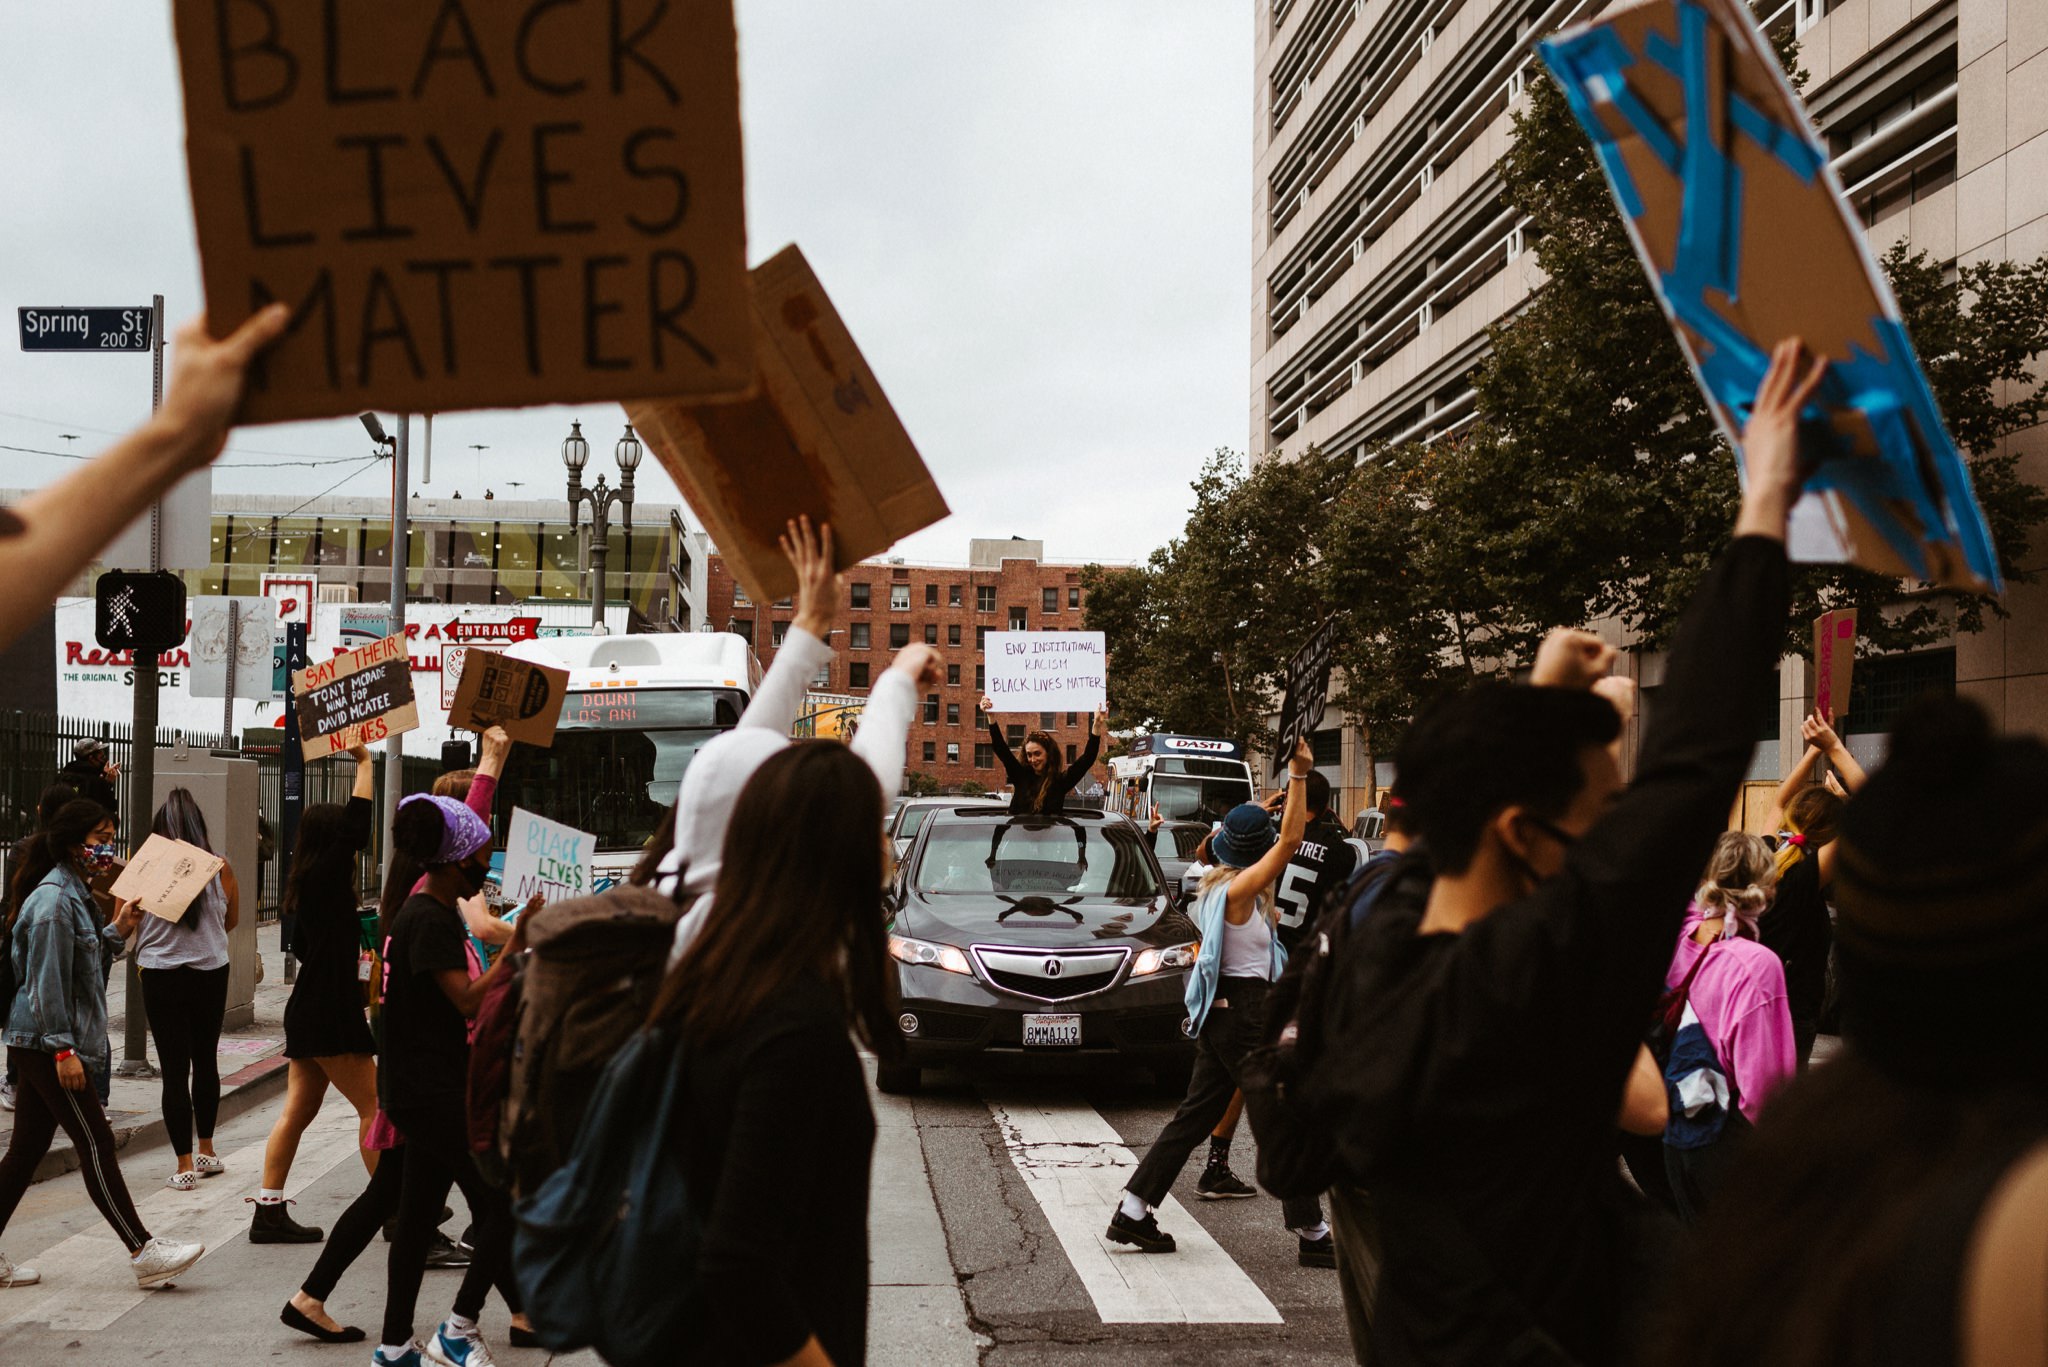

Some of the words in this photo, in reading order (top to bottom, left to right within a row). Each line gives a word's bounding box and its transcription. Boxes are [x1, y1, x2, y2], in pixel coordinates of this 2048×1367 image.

[213, 0, 682, 112] BLACK
[240, 120, 690, 248] LIVES
[26, 310, 88, 339] Spring
[121, 310, 143, 332] St
[248, 249, 718, 394] MATTER
[100, 332, 127, 347] 200
[135, 332, 143, 347] S
[457, 625, 526, 636] ENTRANCE
[1006, 642, 1026, 655] END
[1032, 641, 1101, 654] INSTITUTIONAL
[306, 659, 336, 689] SAY
[350, 637, 398, 669] THEIR
[1025, 658, 1068, 670] RACISM
[64, 673, 78, 681] THE
[82, 673, 118, 682] ORIGINAL
[124, 671, 181, 687] SCE
[992, 677, 1030, 692] BLACK
[1034, 678, 1062, 691] LIVES
[1067, 676, 1106, 691] MATTER
[309, 682, 345, 706] TONY
[326, 697, 348, 713] NINA
[352, 688, 368, 703] POP
[318, 711, 347, 733] DAVID
[567, 709, 601, 722] LOS
[1281, 692, 1326, 762] STAND
[330, 718, 388, 752] NES
[1176, 740, 1222, 750] DASH
[527, 820, 582, 865] BLACK
[1295, 841, 1328, 863] TREE
[538, 858, 583, 889] LIVES
[1027, 1026, 1077, 1040] 8MMA119
